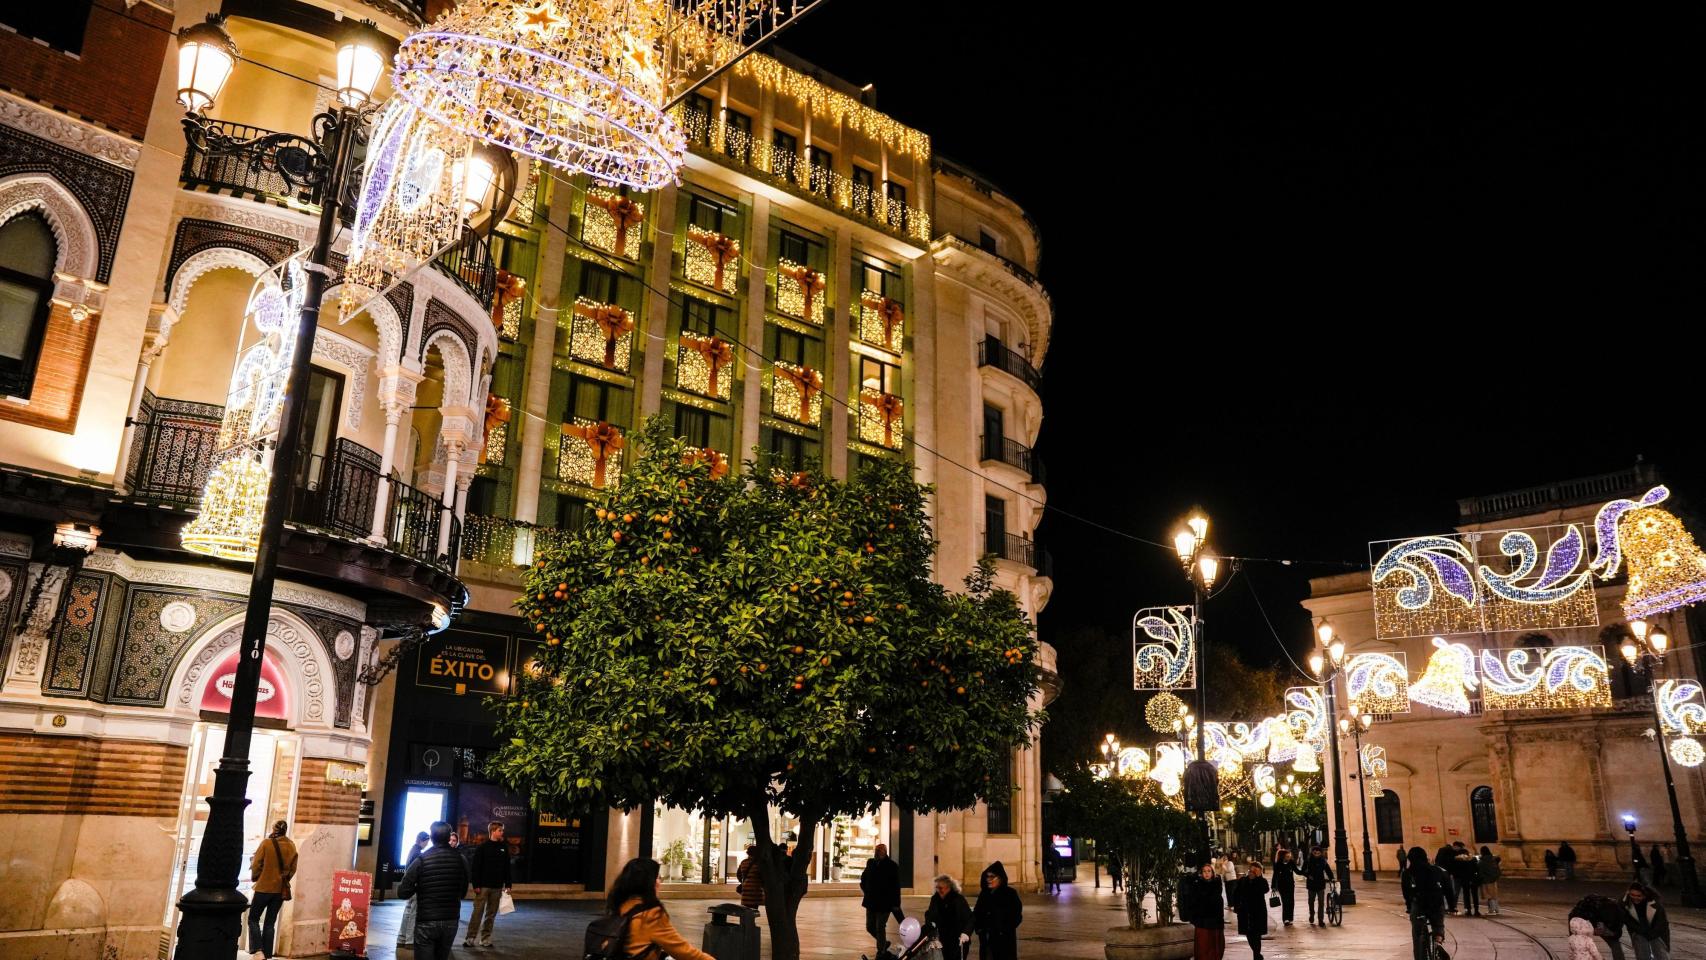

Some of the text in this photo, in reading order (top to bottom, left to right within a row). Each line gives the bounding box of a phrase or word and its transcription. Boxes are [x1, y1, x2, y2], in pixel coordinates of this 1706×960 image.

[430, 654, 494, 681] ÉXITO
[341, 877, 352, 886] Stay
[339, 885, 351, 894] keep
